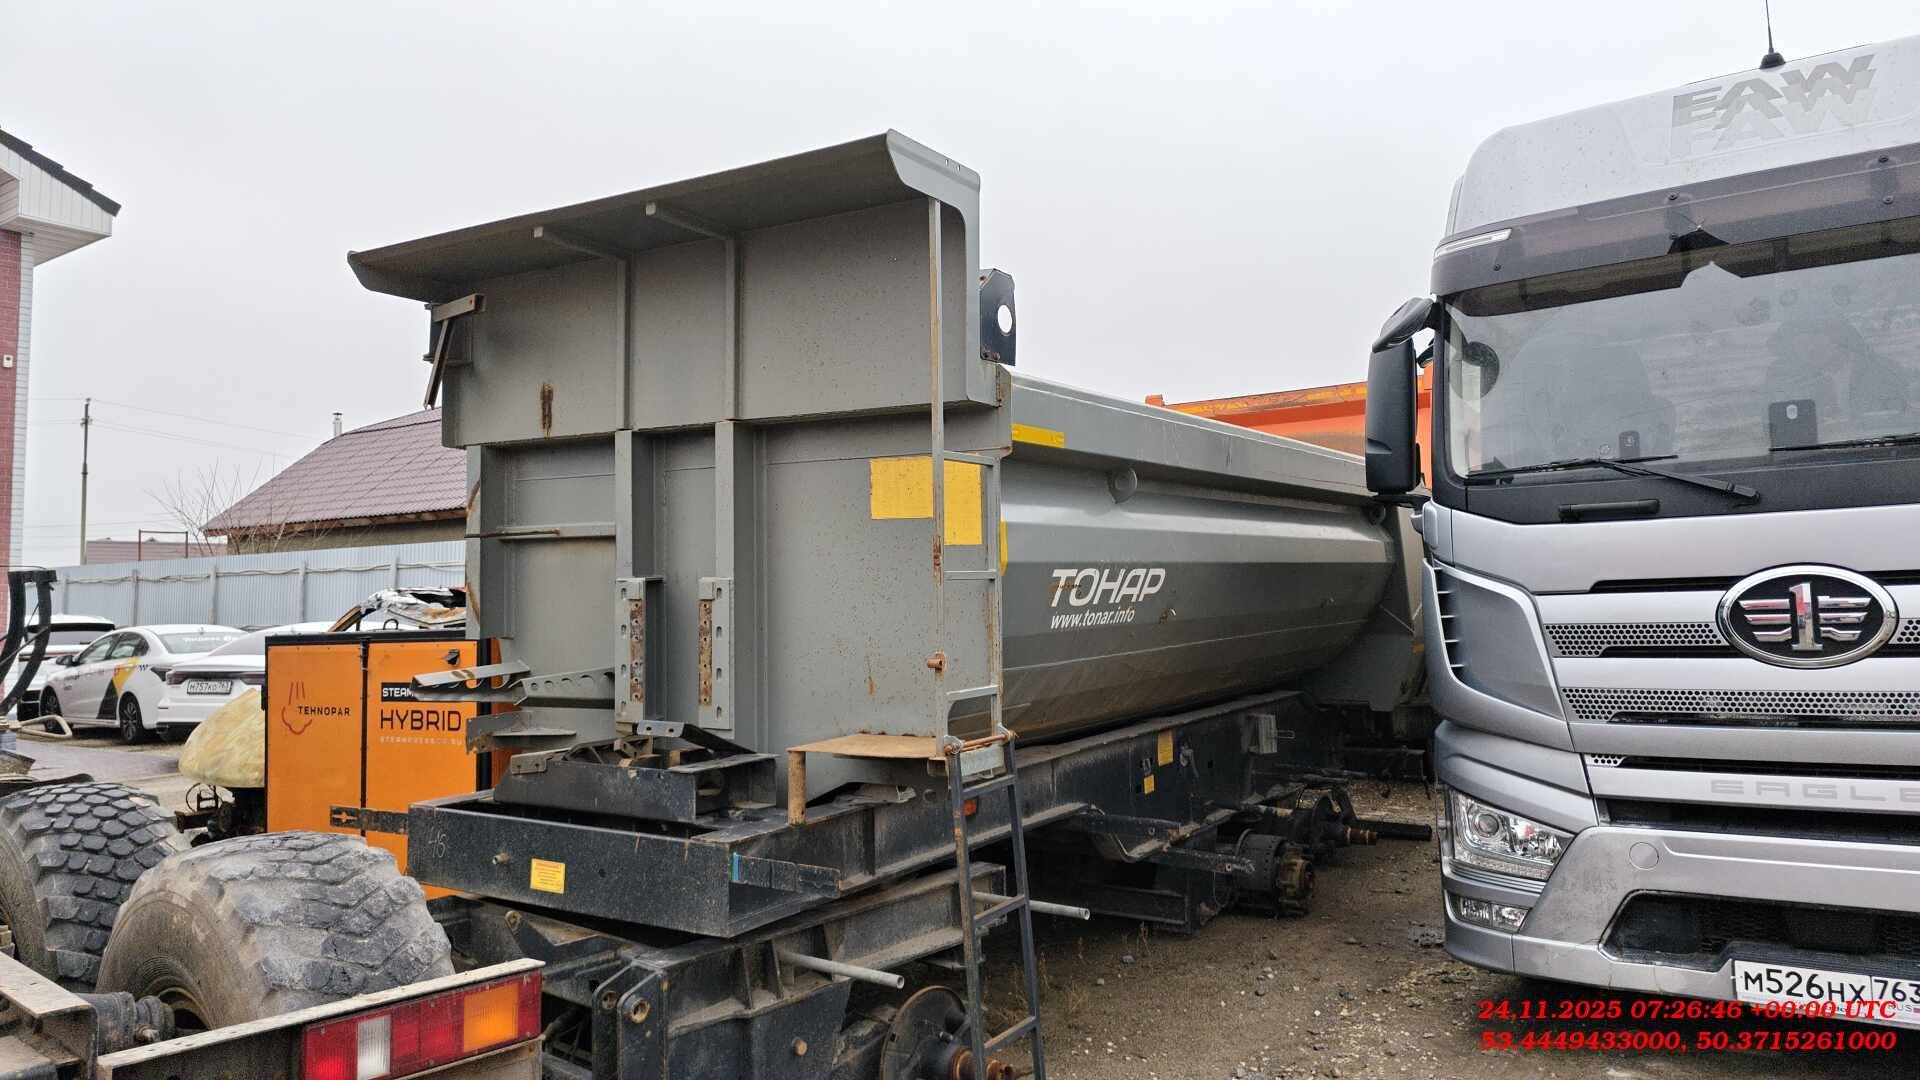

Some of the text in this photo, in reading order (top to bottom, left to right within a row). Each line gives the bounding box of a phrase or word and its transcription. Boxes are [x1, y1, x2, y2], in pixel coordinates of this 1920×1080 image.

[1051, 568, 1166, 607] ТОНАР
[1051, 607, 1136, 629] www.tonar.info
[297, 705, 351, 717] TEHNOPAR
[380, 709, 462, 731] HYBRID
[1873, 978, 1920, 1004] 763
